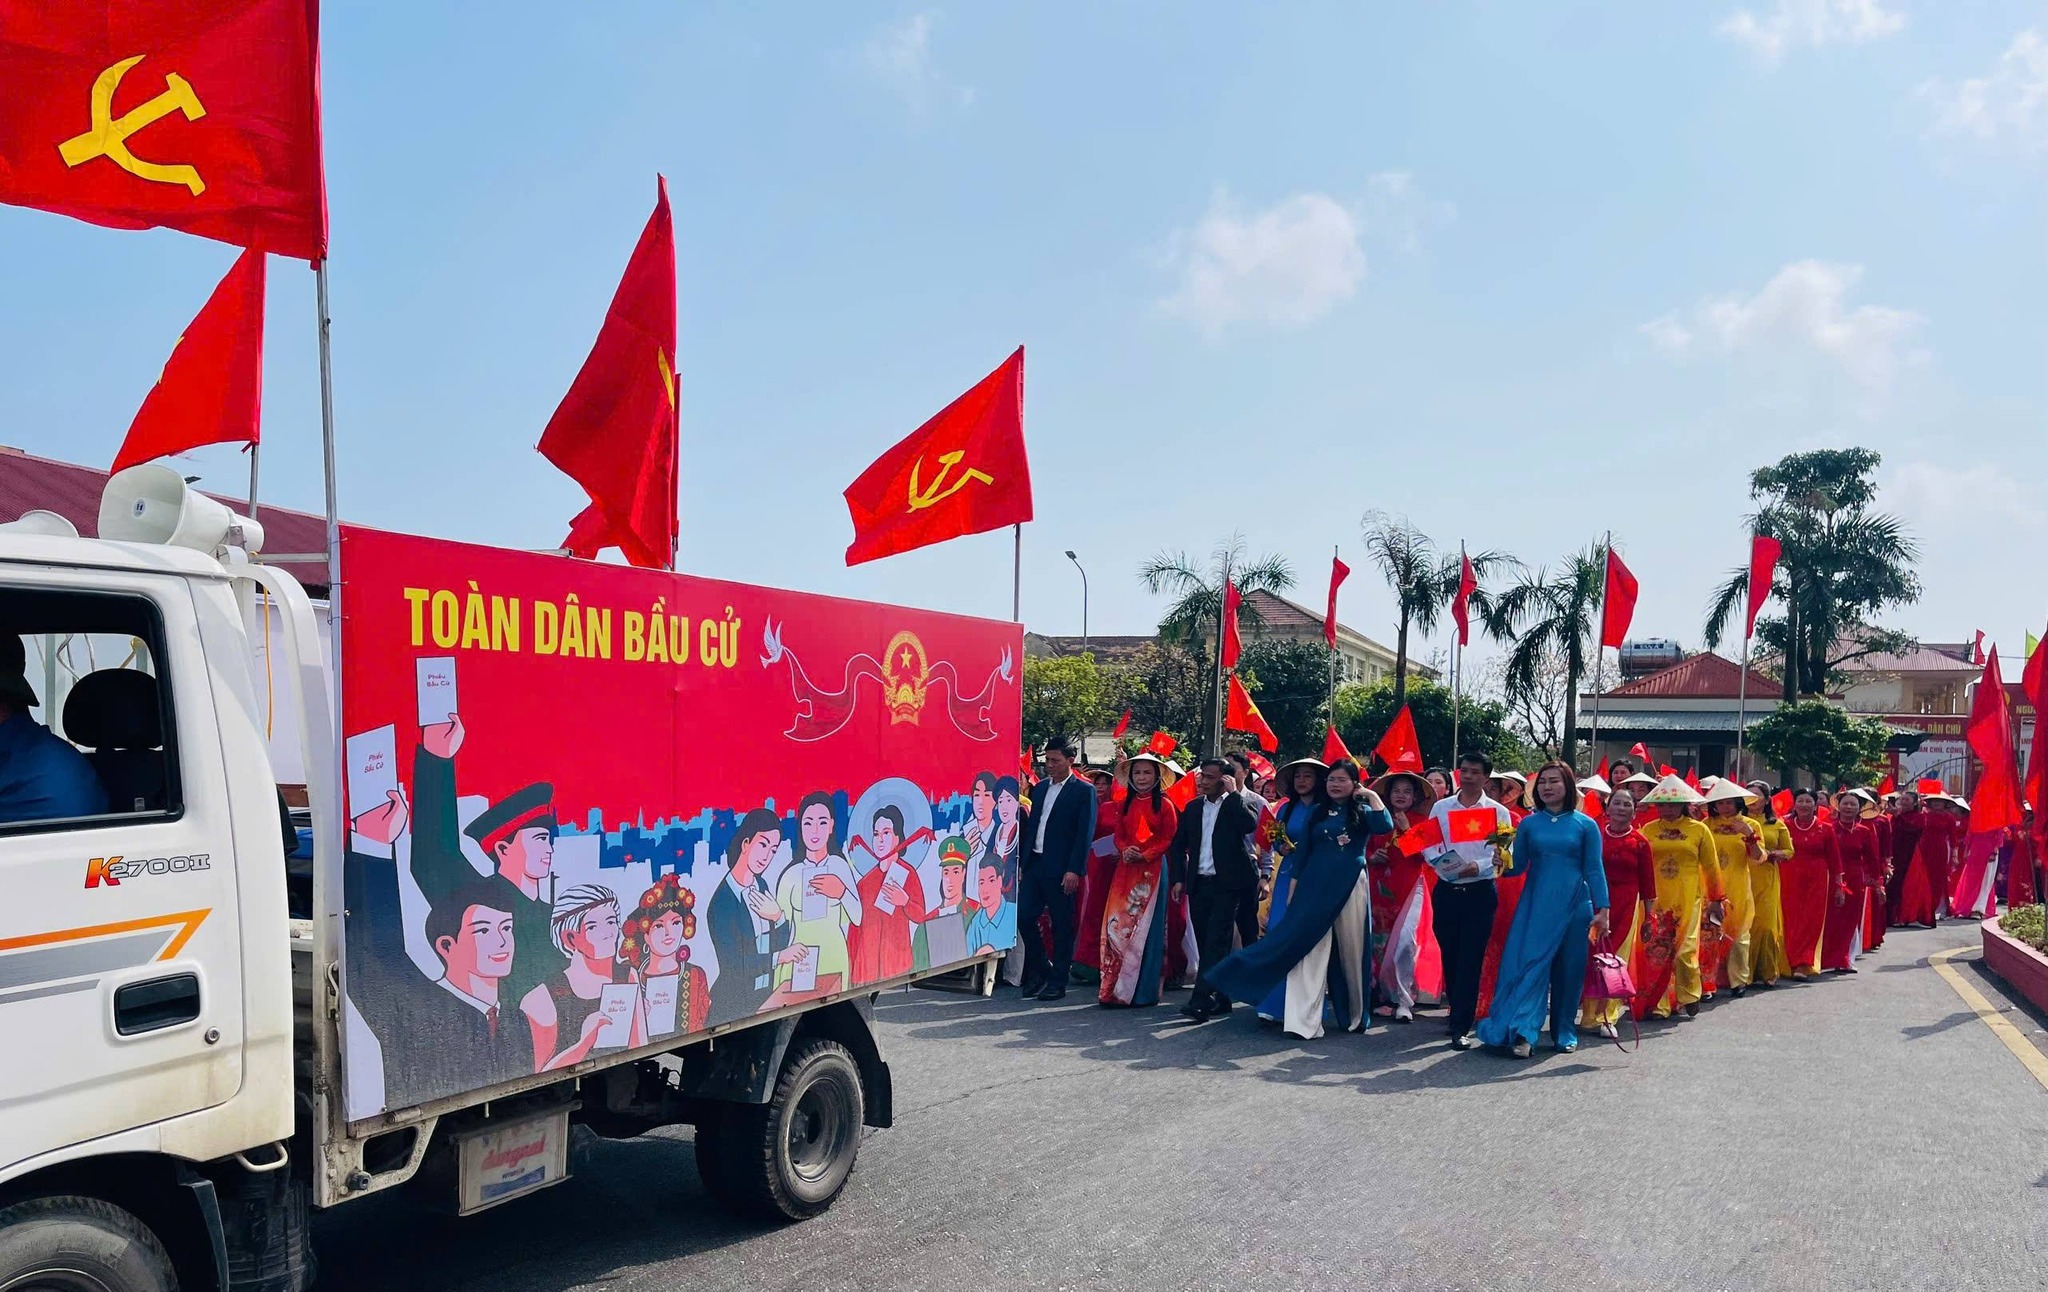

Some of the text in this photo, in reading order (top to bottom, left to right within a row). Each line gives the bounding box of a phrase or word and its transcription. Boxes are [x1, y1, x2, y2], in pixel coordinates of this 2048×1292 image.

[403, 580, 741, 668] TOÀN DÂN BẦU CỬ
